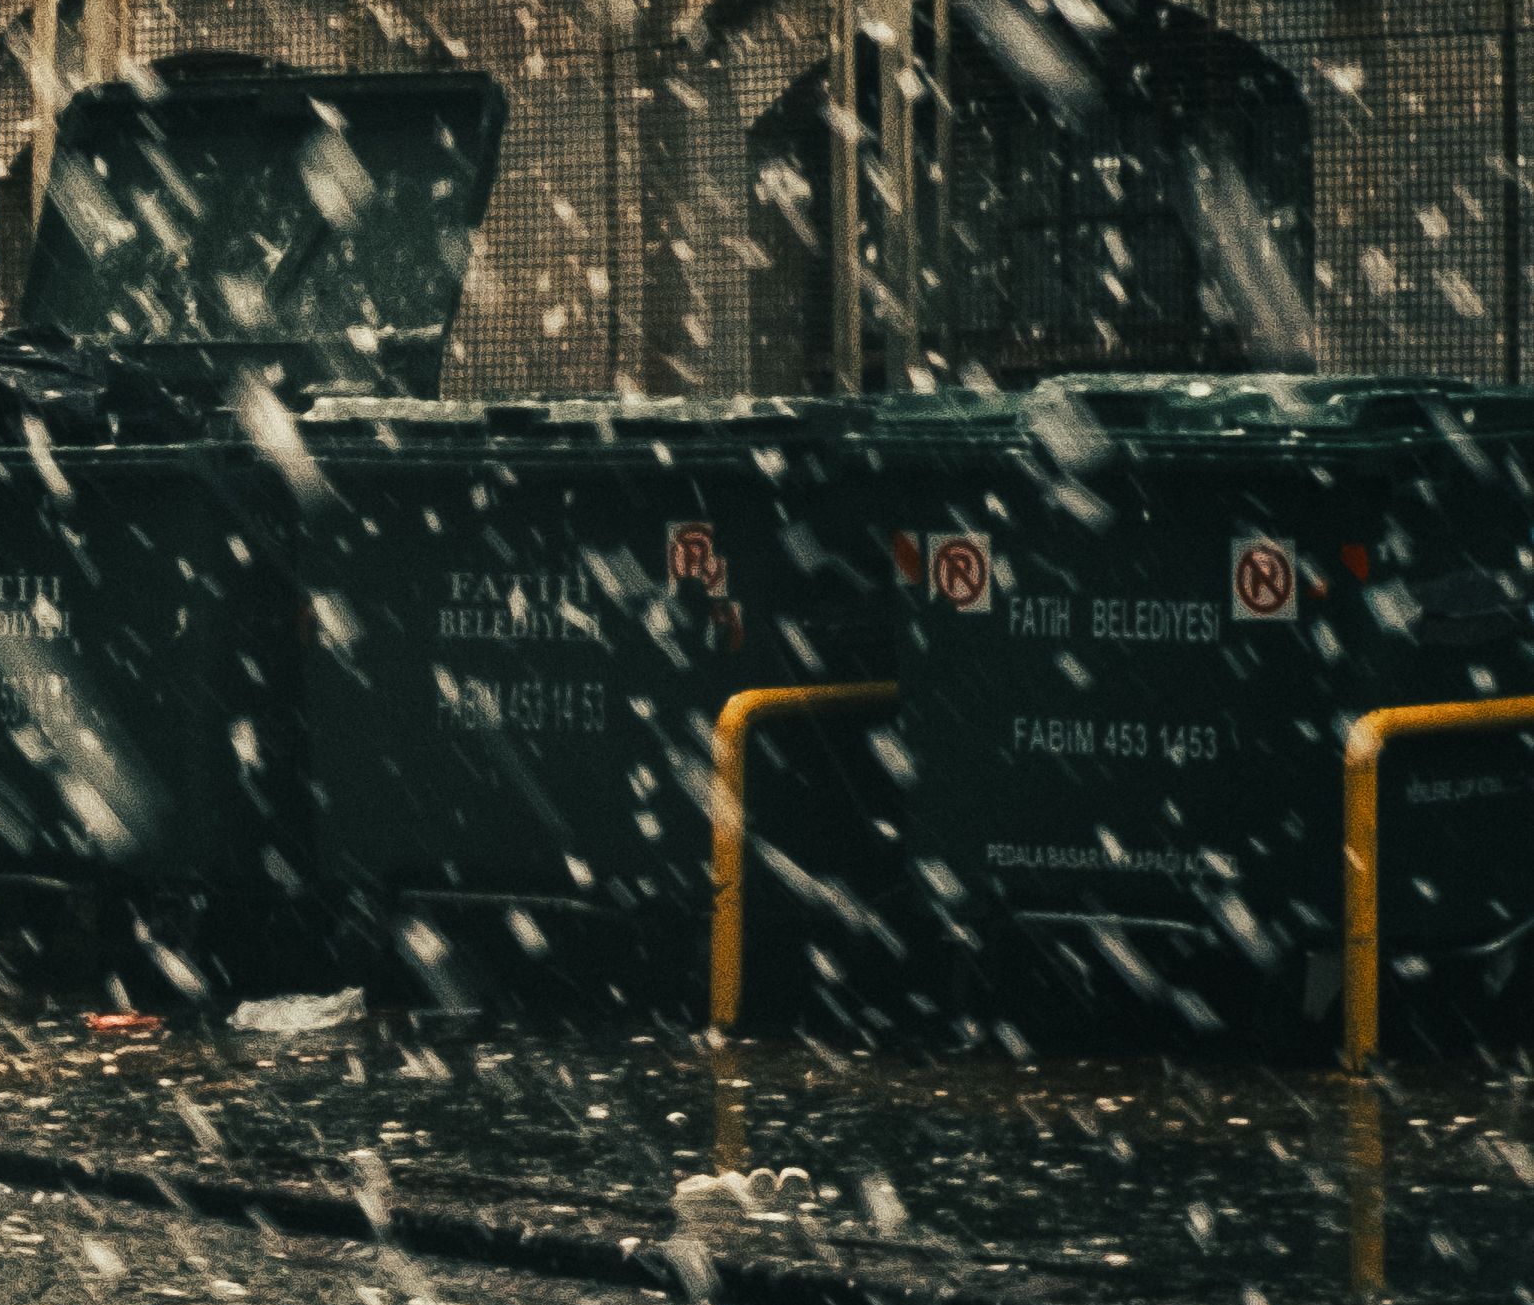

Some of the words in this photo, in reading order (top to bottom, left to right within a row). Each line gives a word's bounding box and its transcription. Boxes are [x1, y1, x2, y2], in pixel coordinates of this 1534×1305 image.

[1009, 597, 1070, 636] FATİH
[1092, 599, 1220, 641] BELEDİYESİ
[1012, 717, 1095, 754] FABİM
[1104, 721, 1147, 758] 453
[1159, 724, 1218, 761] 1453
